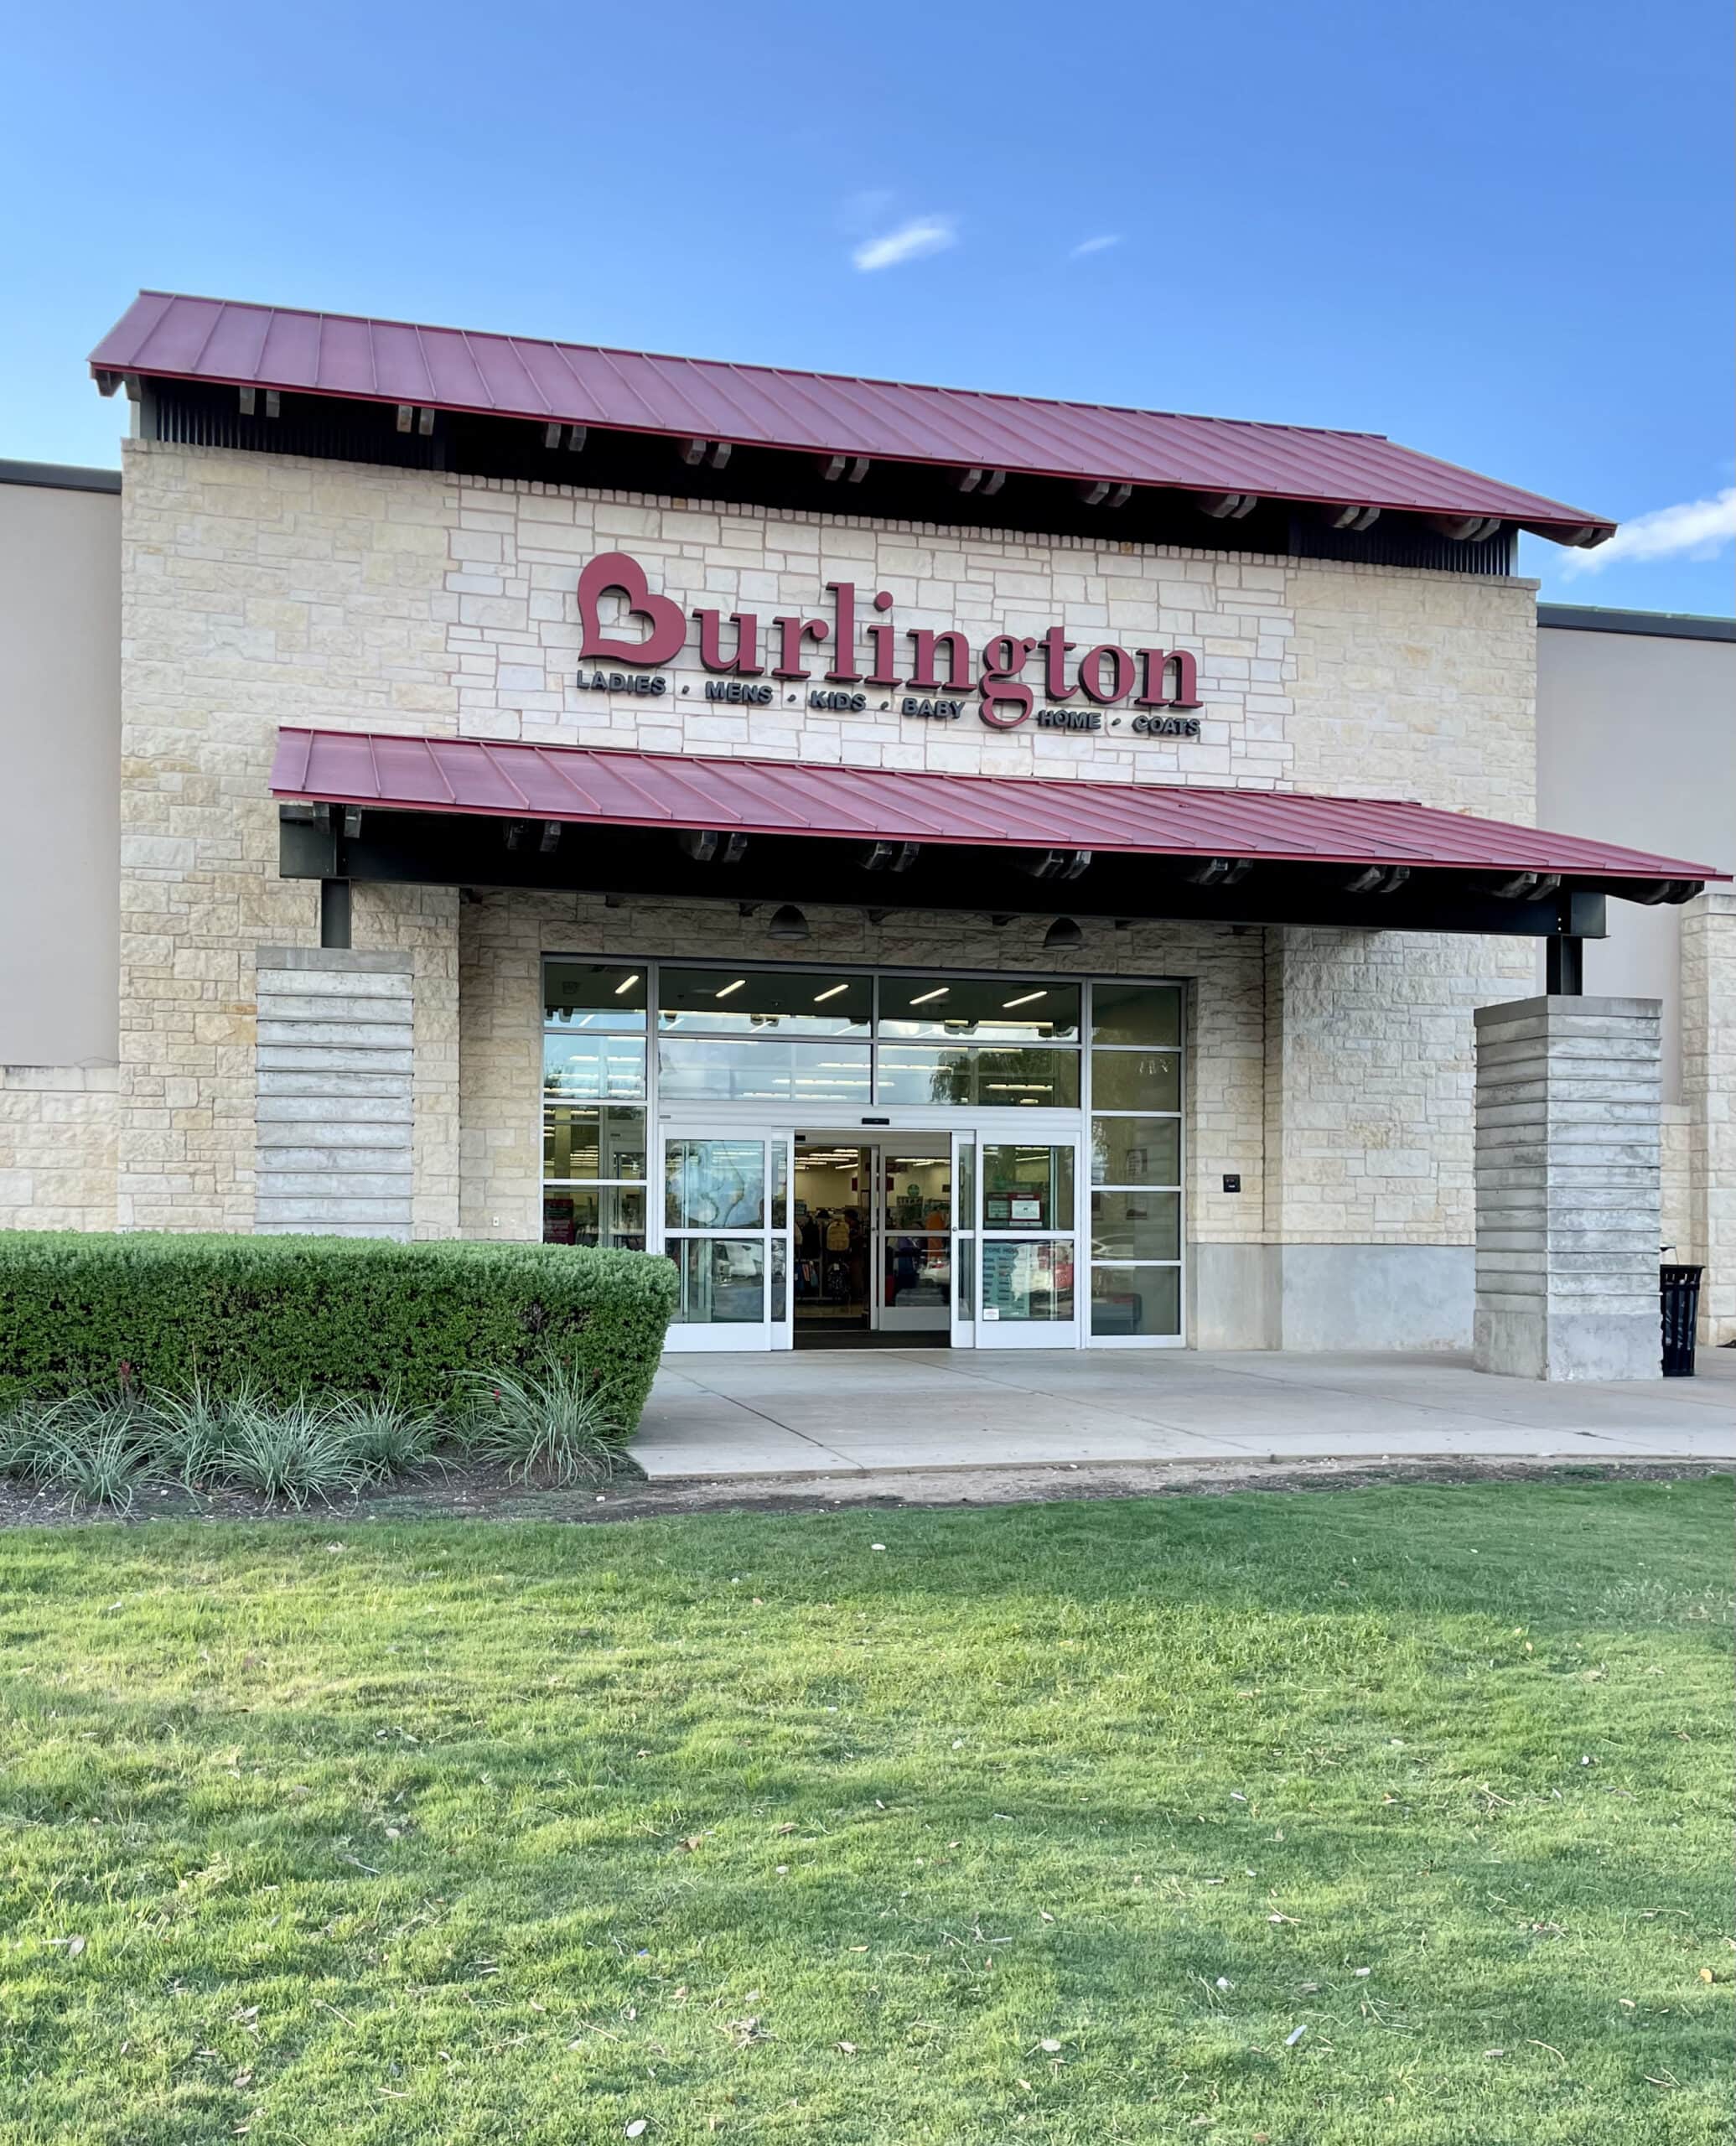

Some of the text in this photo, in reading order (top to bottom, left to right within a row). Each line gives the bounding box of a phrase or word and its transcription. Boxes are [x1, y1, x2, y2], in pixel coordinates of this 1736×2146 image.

[577, 551, 1204, 729] Burlington
[577, 670, 1200, 735] LADIES MENS KIDS BABY HOME COATS
